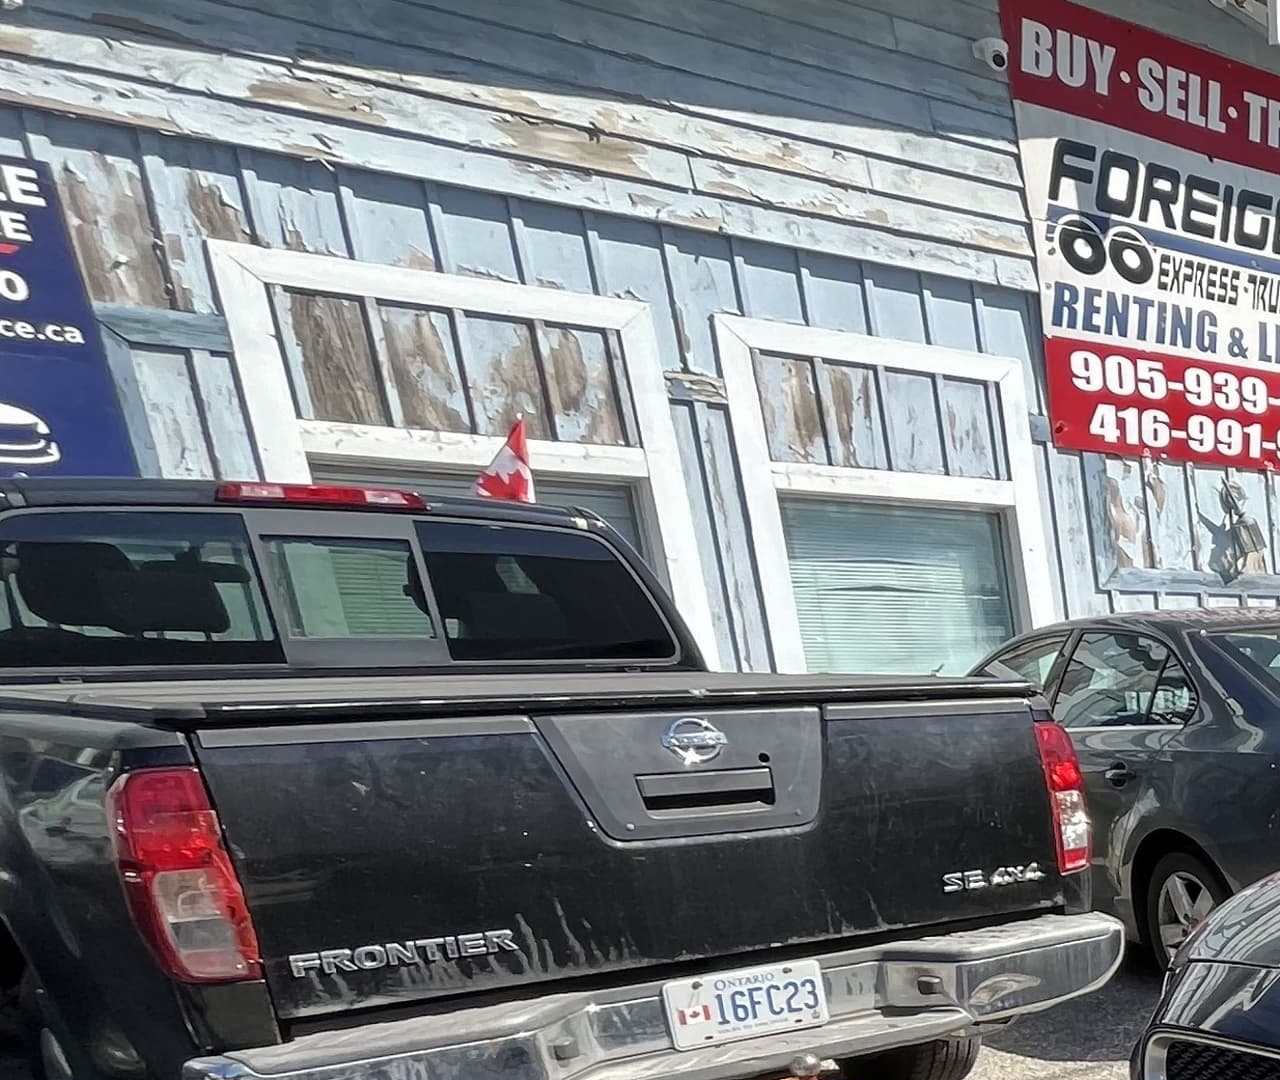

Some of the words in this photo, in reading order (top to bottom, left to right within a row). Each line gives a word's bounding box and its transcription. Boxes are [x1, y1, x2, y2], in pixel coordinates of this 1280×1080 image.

[1020, 17, 1116, 96] BUY
[1137, 57, 1226, 134] SELL
[1157, 253, 1241, 306] EXPRESS
[1051, 281, 1218, 354] RENTING
[1228, 326, 1249, 359] &
[942, 869, 988, 893] SE
[288, 928, 520, 978] FRONTIER
[714, 978, 820, 1026] 16FC23
